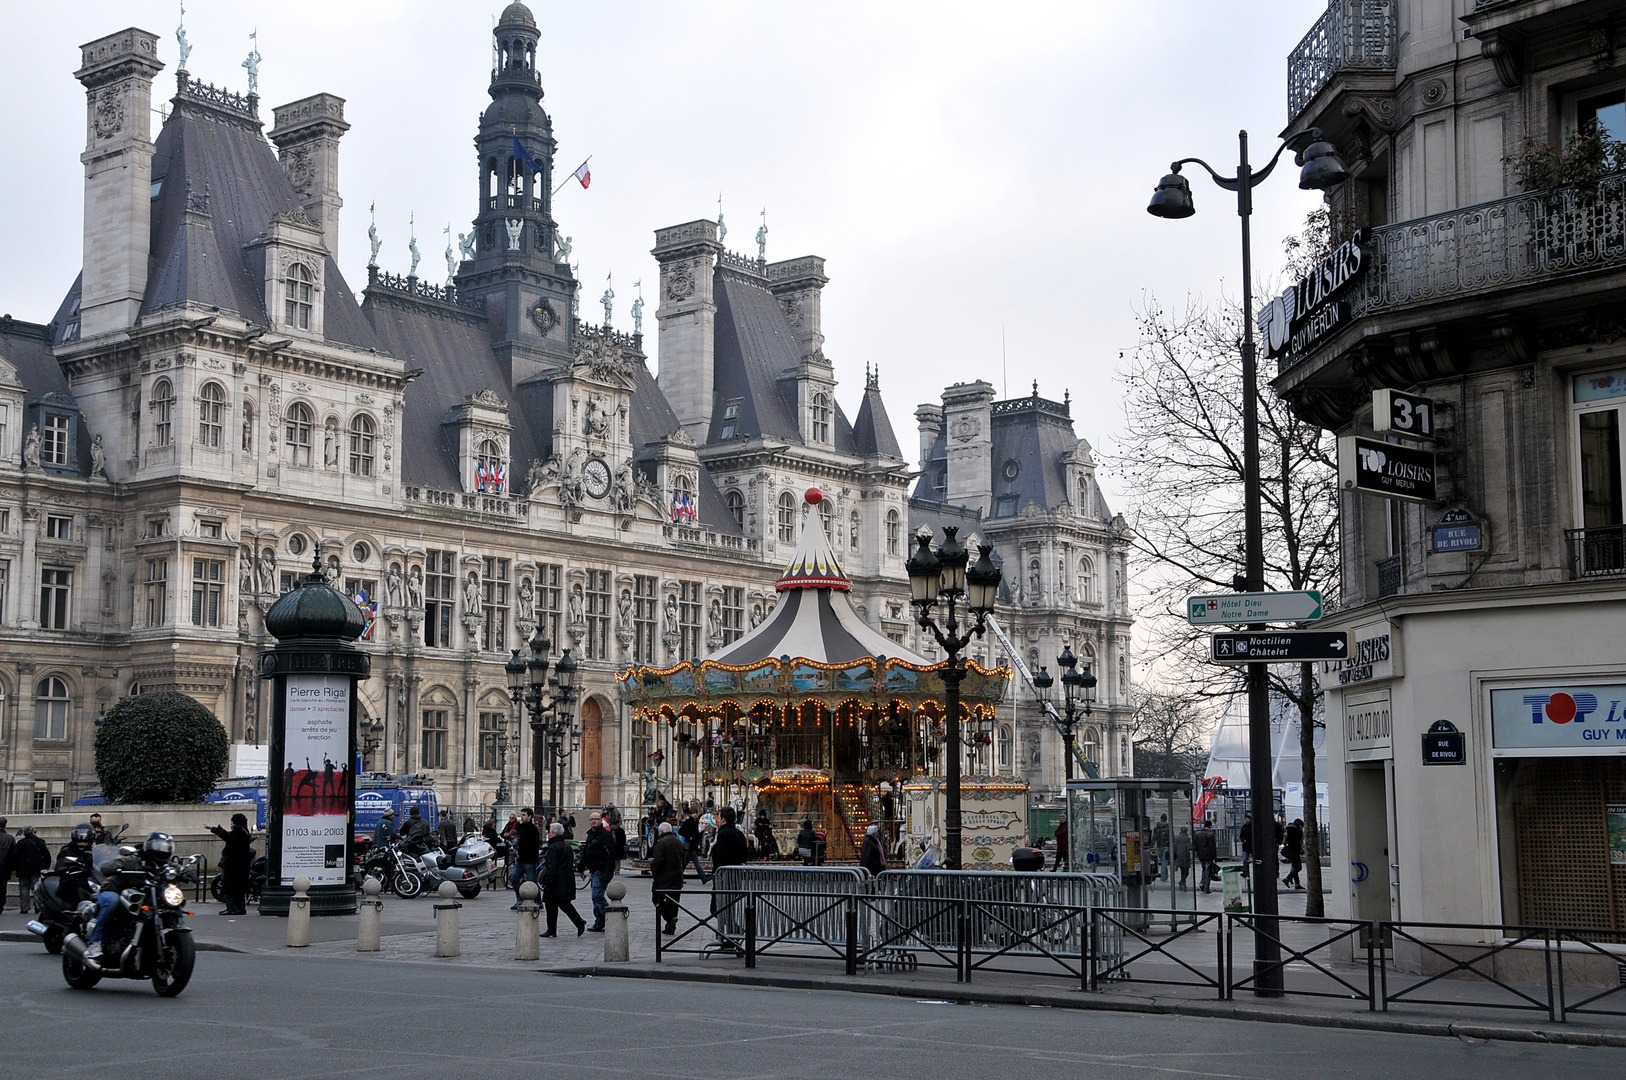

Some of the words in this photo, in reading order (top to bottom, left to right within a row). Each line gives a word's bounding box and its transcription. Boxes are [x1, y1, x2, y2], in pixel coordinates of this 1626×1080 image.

[1258, 286, 1295, 359] TOP
[1295, 229, 1363, 320] LOISIRS
[1291, 322, 1308, 354] GUY
[1307, 302, 1339, 344] MERLIN
[1394, 398, 1430, 434] 31
[1358, 447, 1387, 473] TOP
[1388, 460, 1432, 483] LOISIRS
[1381, 476, 1393, 485] GUY
[1395, 479, 1416, 490] MERLIN
[1448, 529, 1467, 538] RUE
[1437, 540, 1449, 548] DE
[1450, 537, 1478, 547] RIVOLI
[1221, 600, 1241, 608] Hôtel
[1244, 599, 1262, 607] Dieu
[1247, 609, 1269, 617] Dame
[1250, 636, 1291, 646] Noctilien
[1249, 648, 1289, 656] Châtelet
[290, 687, 320, 697] Pierre
[323, 687, 346, 699] Rigal
[1523, 692, 1598, 725] TOP
[1605, 700, 1626, 722] L
[1582, 729, 1610, 740] GUY
[310, 829, 322, 837] au
